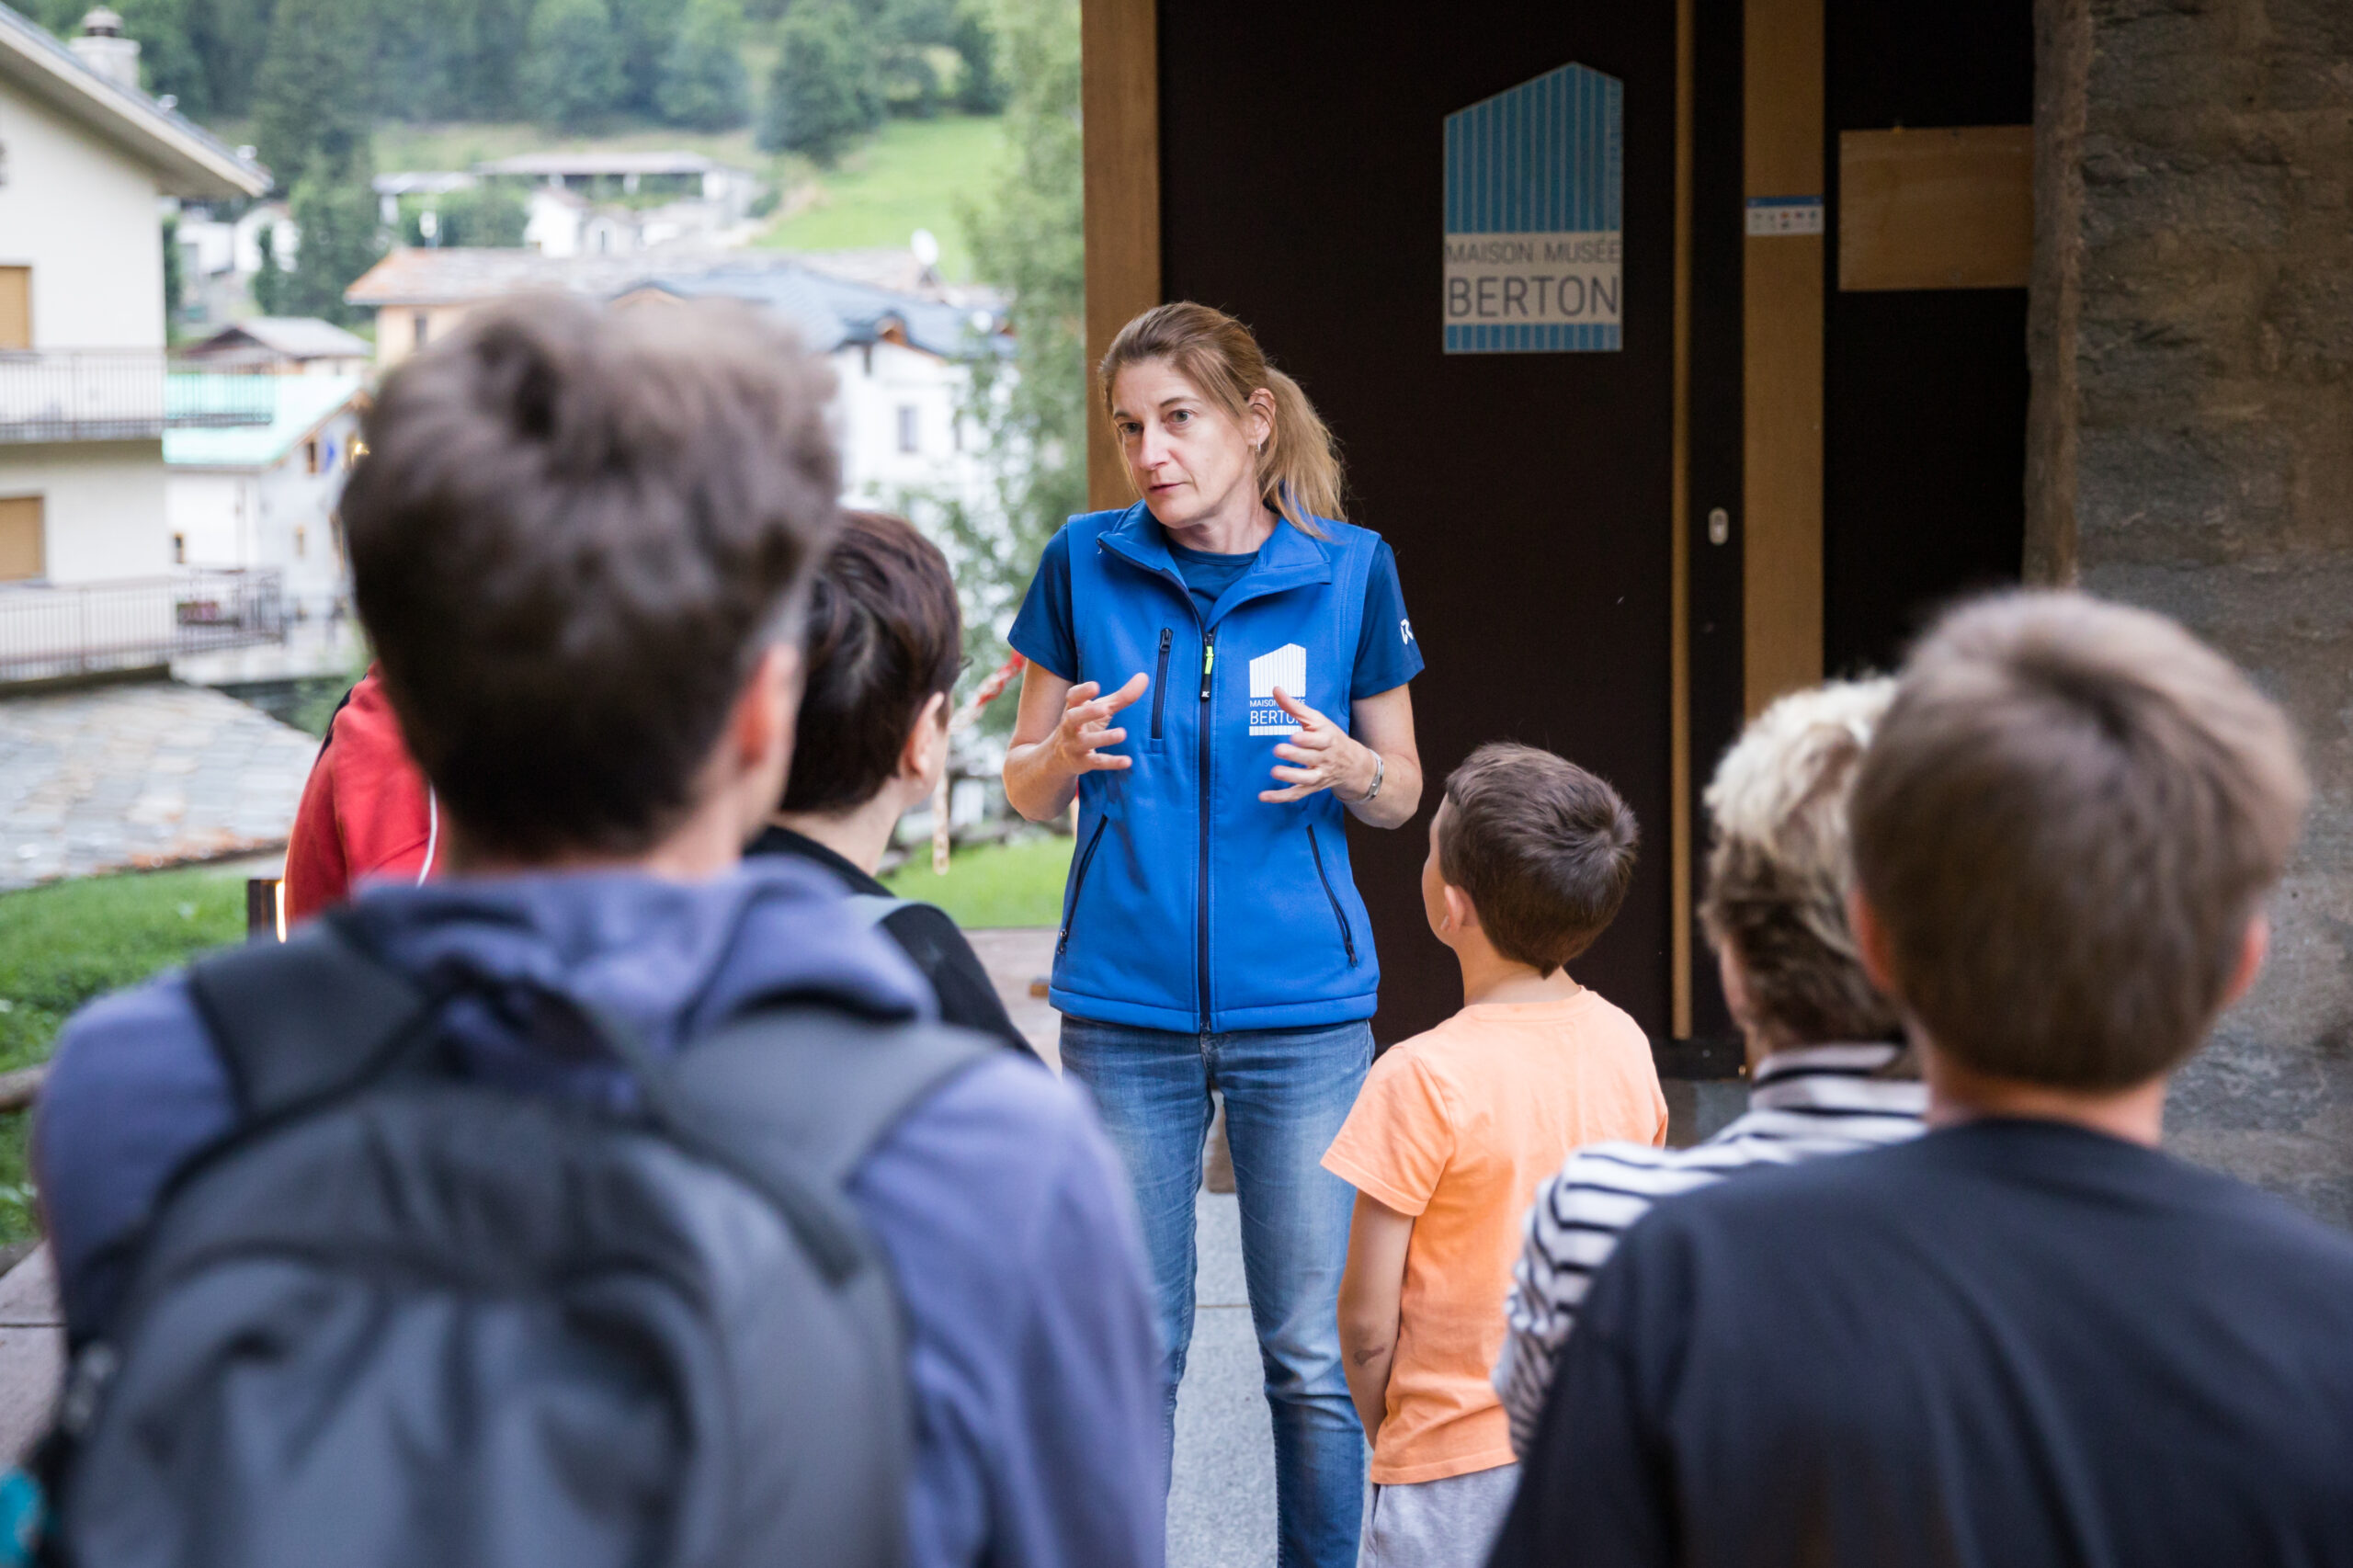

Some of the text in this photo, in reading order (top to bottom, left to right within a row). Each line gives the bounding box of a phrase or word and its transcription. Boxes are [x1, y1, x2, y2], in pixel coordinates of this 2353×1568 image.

[1445, 238, 1622, 265] MAISON MUSÉE
[1447, 275, 1621, 319] BERTON
[1250, 710, 1299, 724] BERTO
